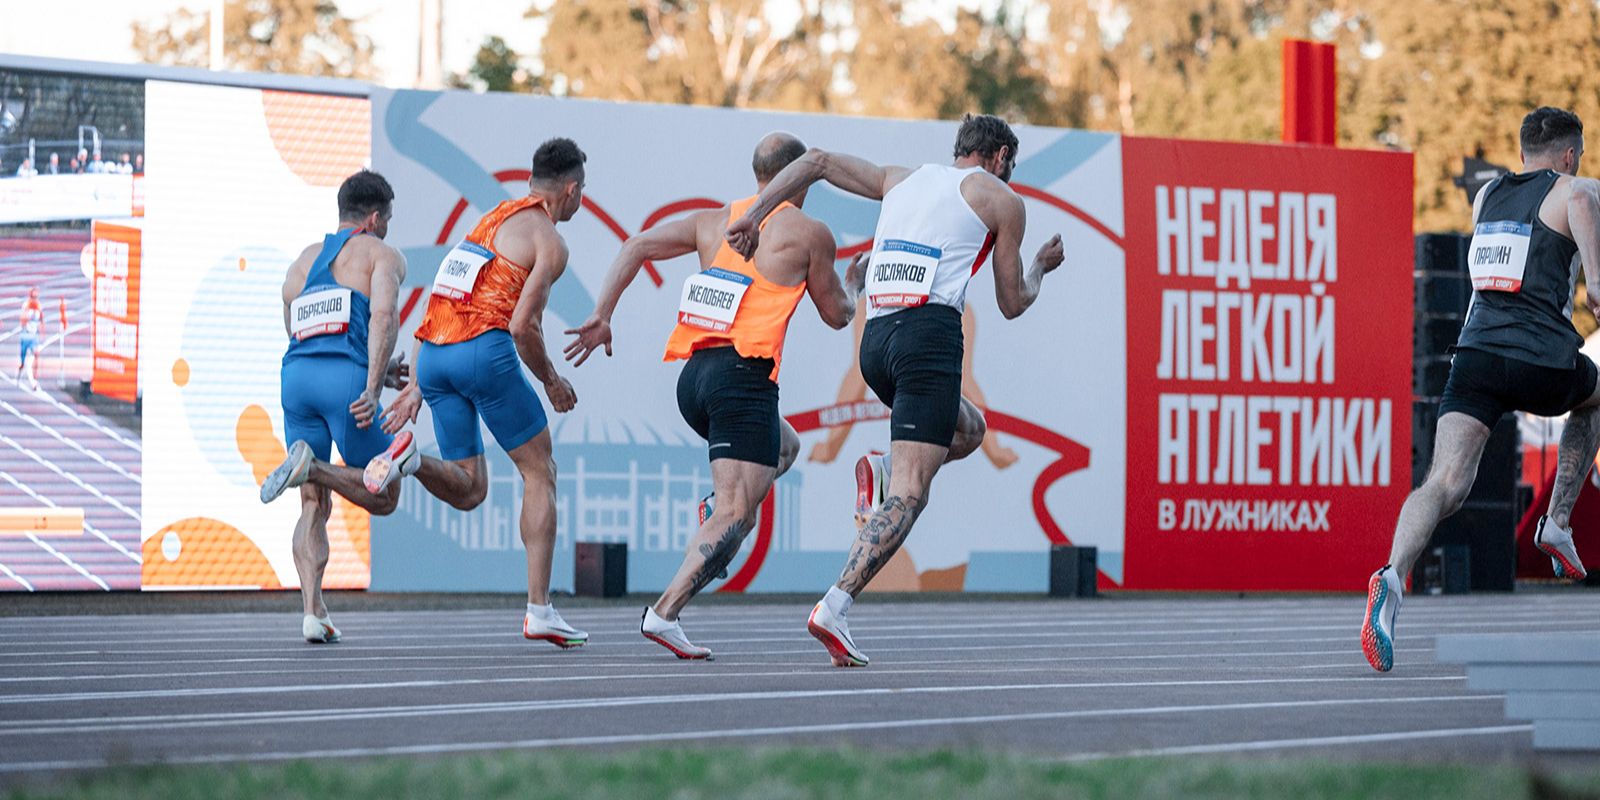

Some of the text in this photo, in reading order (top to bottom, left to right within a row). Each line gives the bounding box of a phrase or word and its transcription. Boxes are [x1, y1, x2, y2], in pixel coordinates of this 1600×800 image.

[1155, 185, 1337, 288] НЕДЕЛЯ
[1474, 245, 1512, 265] ПАРШИН
[873, 263, 926, 283] РОСЛЯКОВ
[297, 297, 342, 321] ОБРАЗЦОВ
[688, 284, 735, 310] ЖЕЛОБАЕВ
[1157, 283, 1335, 384] ЛЕГКОЙ
[1158, 393, 1392, 486] АТЛЕТИКИ
[1158, 499, 1330, 532] В ЛУЖНИКАХ
